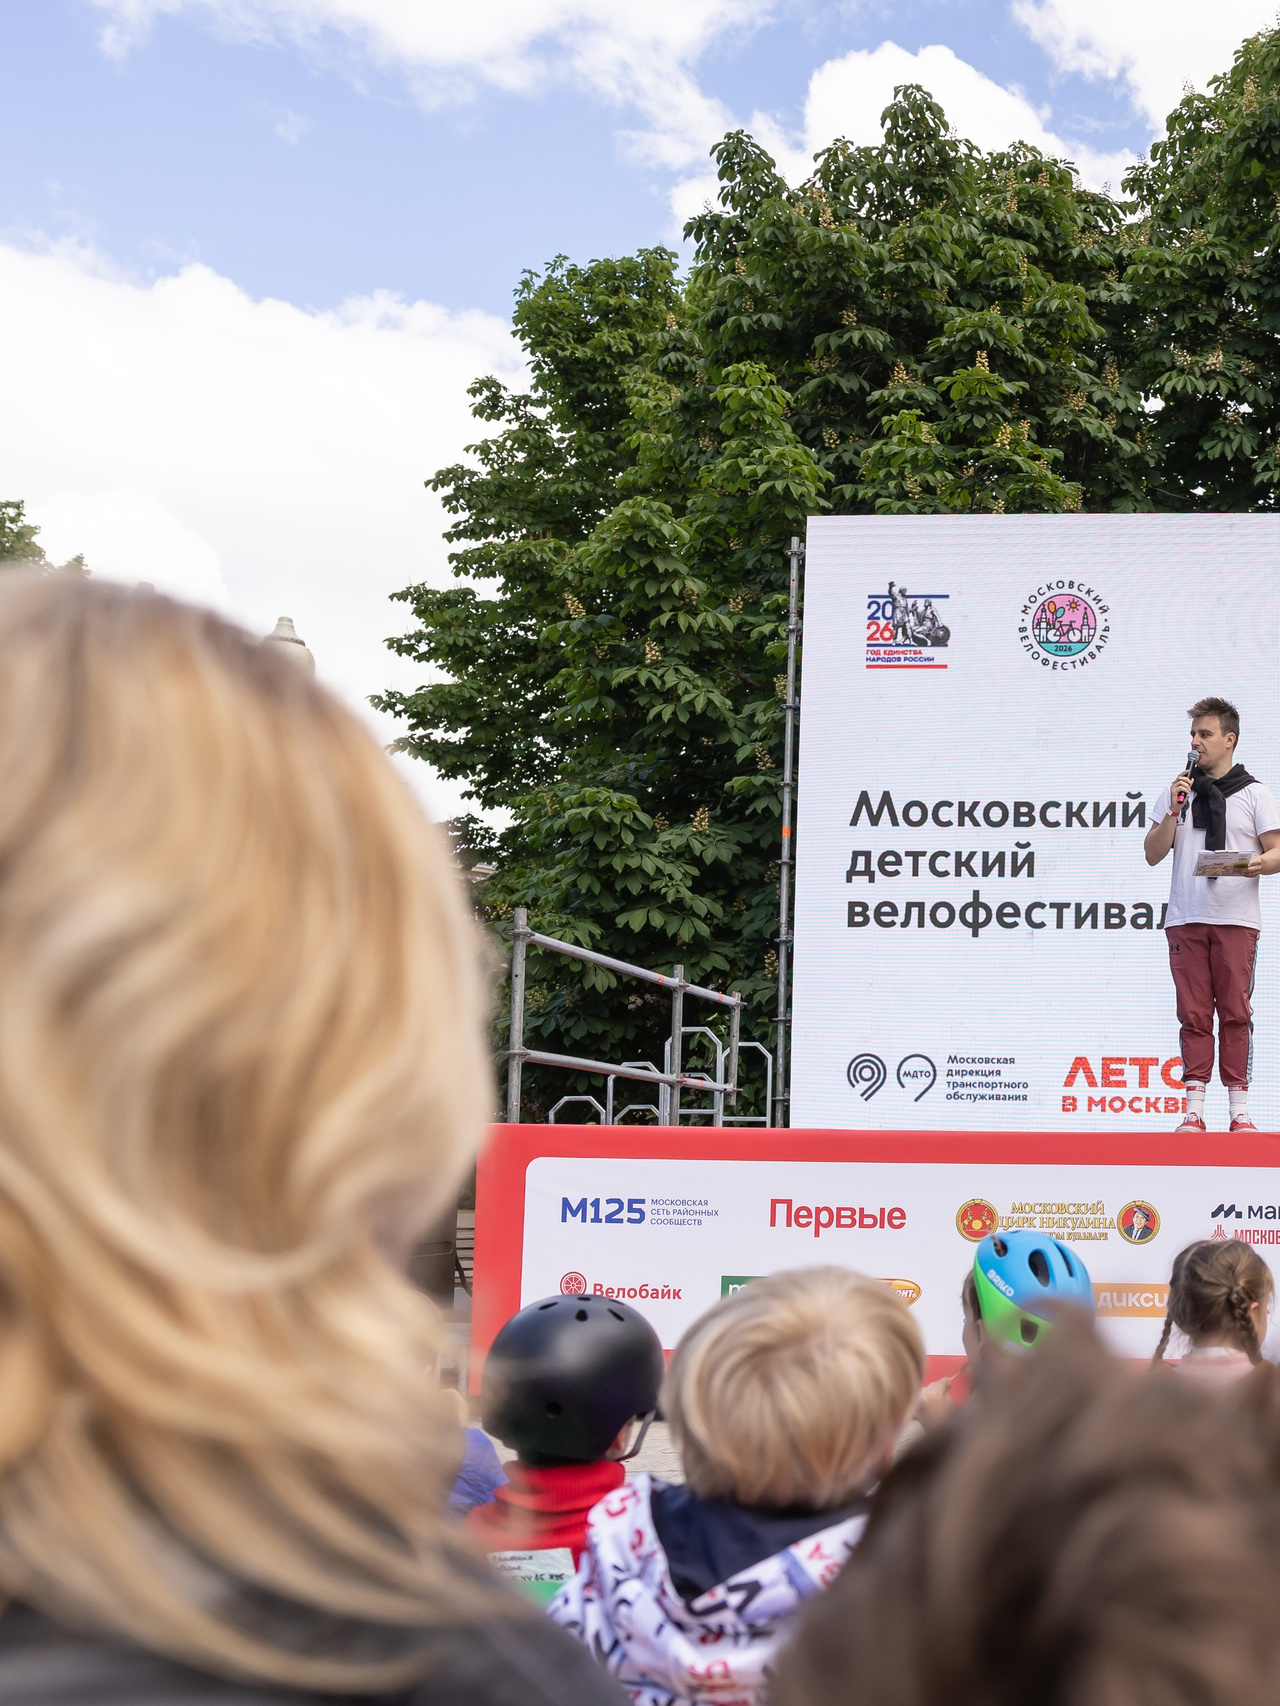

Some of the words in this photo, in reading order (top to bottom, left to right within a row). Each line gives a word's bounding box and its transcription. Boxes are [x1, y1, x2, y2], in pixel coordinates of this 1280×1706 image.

[1021, 580, 1110, 615] МОСКОВСКИЙ
[867, 600, 895, 621] 20
[866, 621, 894, 642] 26
[1018, 625, 1110, 671] ВЕЛОФЕСТИВАЛЬ
[849, 790, 1146, 828] Московский
[846, 841, 1035, 883] детский
[847, 889, 1168, 938] велофестивал
[946, 1055, 1015, 1065] Московская
[946, 1069, 1001, 1077] дирекция
[1063, 1056, 1187, 1090] ЛЕТО
[946, 1080, 1029, 1090] транспортного
[946, 1091, 1028, 1102] обслуживания
[1062, 1096, 1077, 1112] В
[650, 1198, 709, 1207] МОСКОВСКАЯ
[1010, 1200, 1105, 1215] МОСКОВСКИЙ
[650, 1208, 671, 1216] СЕТЬ
[672, 1207, 719, 1217] РАЙОННЫХ
[769, 1199, 907, 1238] Первые
[650, 1218, 703, 1227] СООБЩЕСТВ
[999, 1216, 1037, 1231] ЦИРК
[1039, 1217, 1117, 1231] НИКУЛИНА
[592, 1283, 682, 1300] Велобайк
